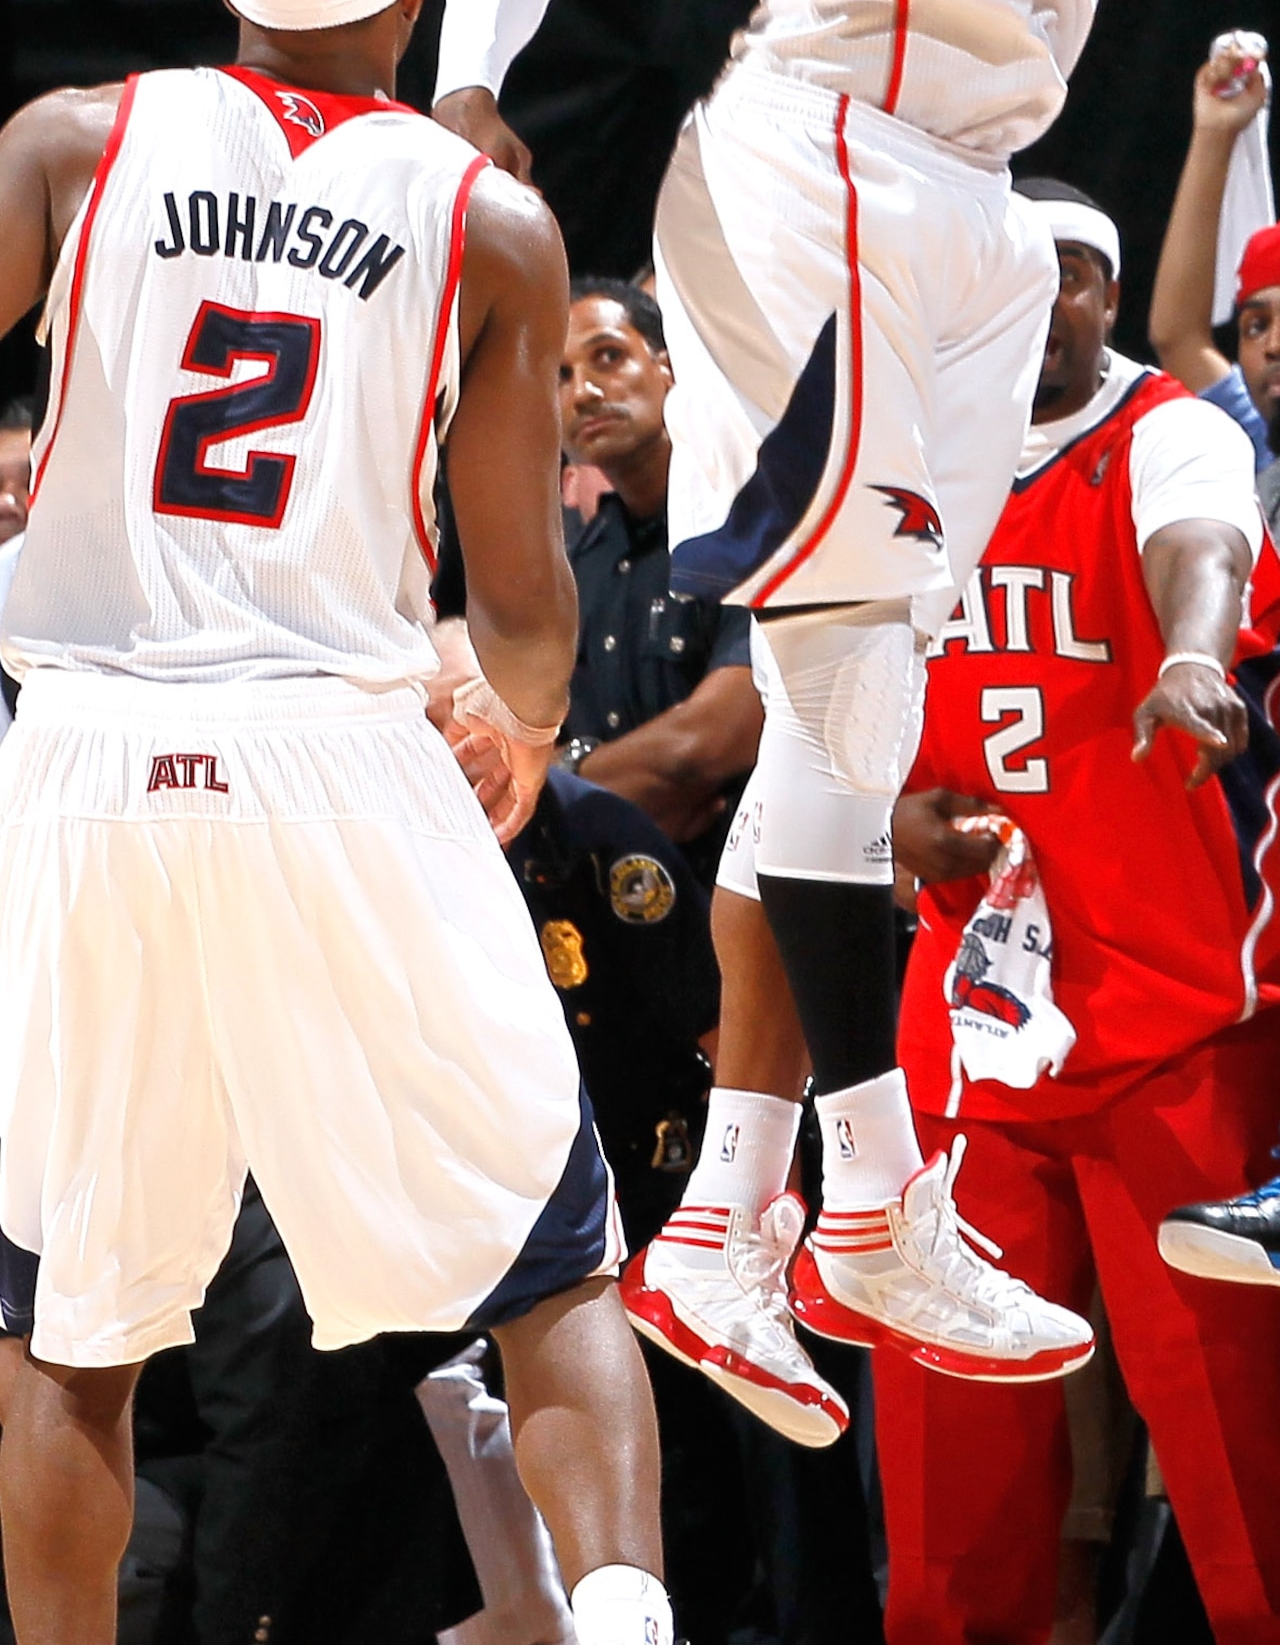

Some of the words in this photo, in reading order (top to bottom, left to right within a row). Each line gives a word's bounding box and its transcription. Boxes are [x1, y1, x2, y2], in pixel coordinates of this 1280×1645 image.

[154, 190, 406, 302] JOHNSON
[152, 299, 322, 530] 2
[926, 565, 1112, 663] ATL
[147, 753, 229, 794] ATL
[980, 686, 1050, 795] 2
[951, 1016, 1010, 1040] ATLANT
